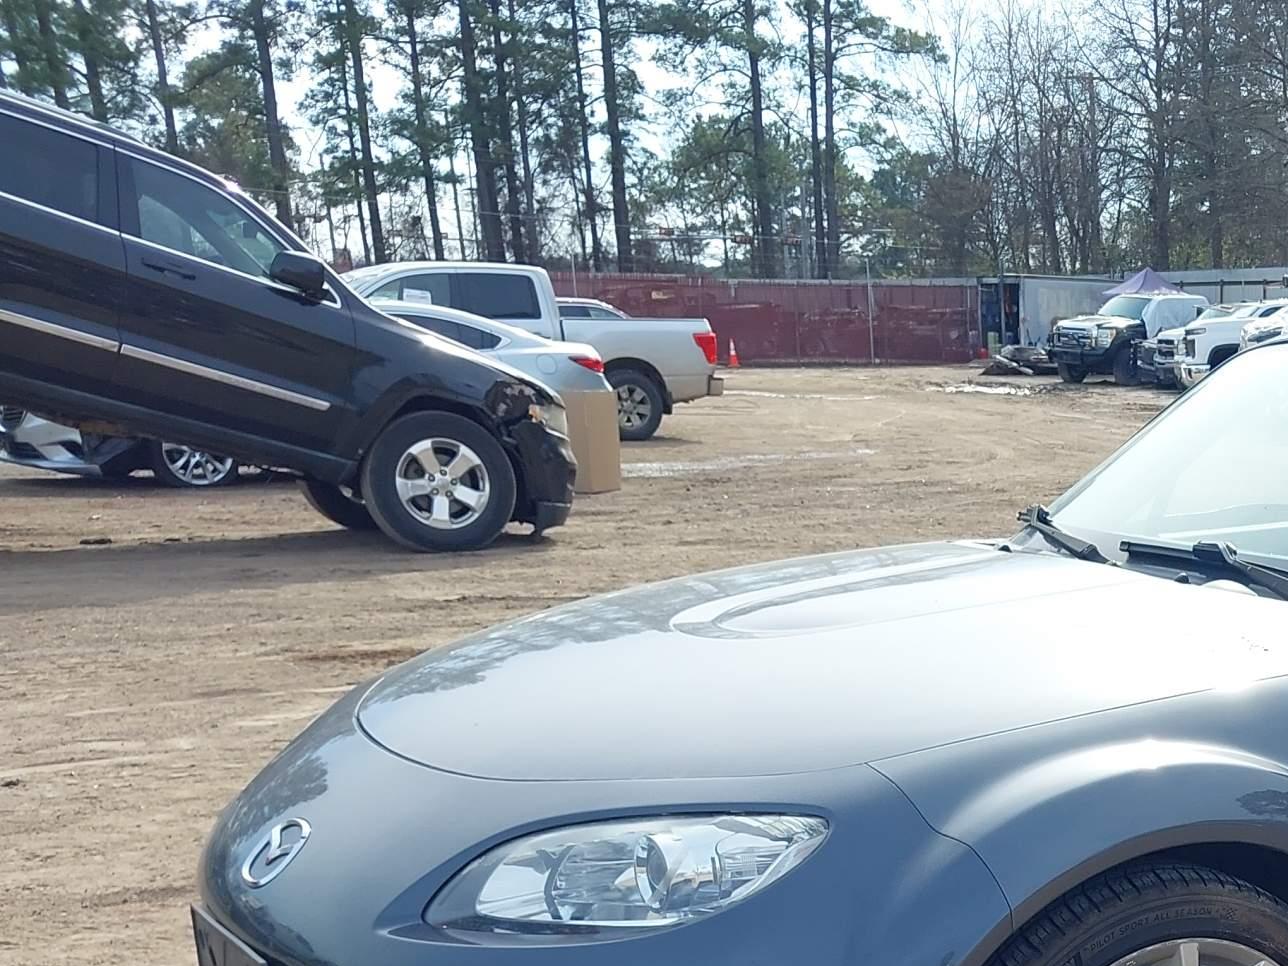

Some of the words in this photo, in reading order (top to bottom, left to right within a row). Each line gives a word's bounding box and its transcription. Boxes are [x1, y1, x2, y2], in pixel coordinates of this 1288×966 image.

[1089, 932, 1115, 951] PILOT
[1119, 917, 1149, 936] SPORT
[1153, 912, 1170, 922] ALL
[1175, 906, 1212, 918] SEASON
